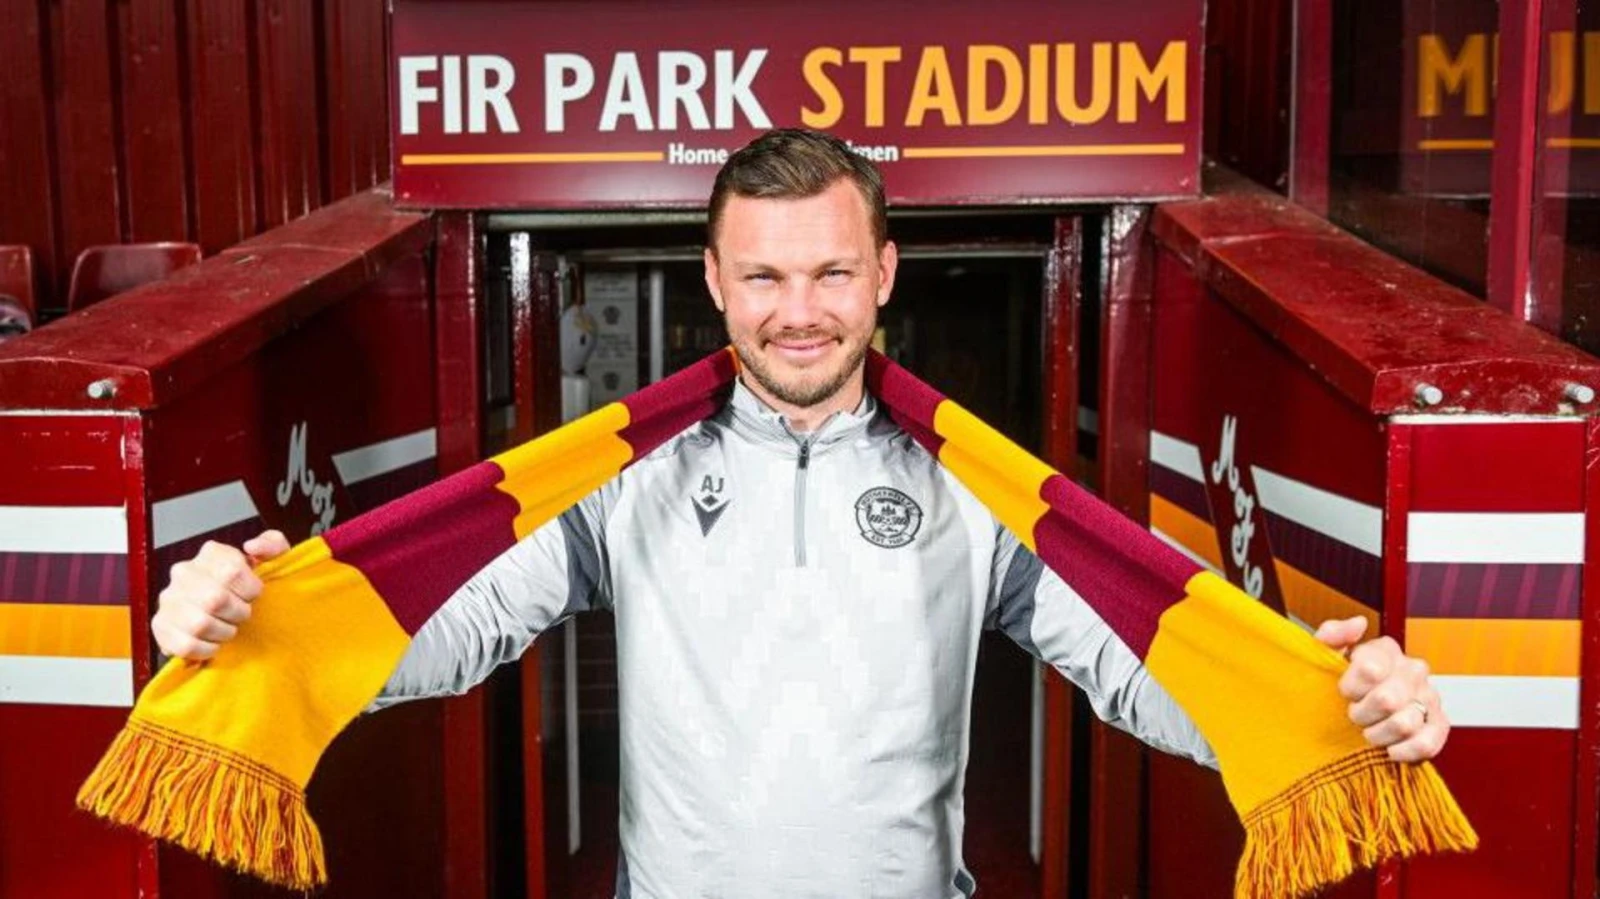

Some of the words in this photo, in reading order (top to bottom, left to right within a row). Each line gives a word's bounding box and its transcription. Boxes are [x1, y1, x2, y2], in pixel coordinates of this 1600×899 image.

[399, 55, 520, 135] FIR
[544, 49, 774, 133] PARK
[801, 41, 1188, 130] STADIUM
[669, 142, 729, 165] Home
[701, 474, 725, 494] AJ
